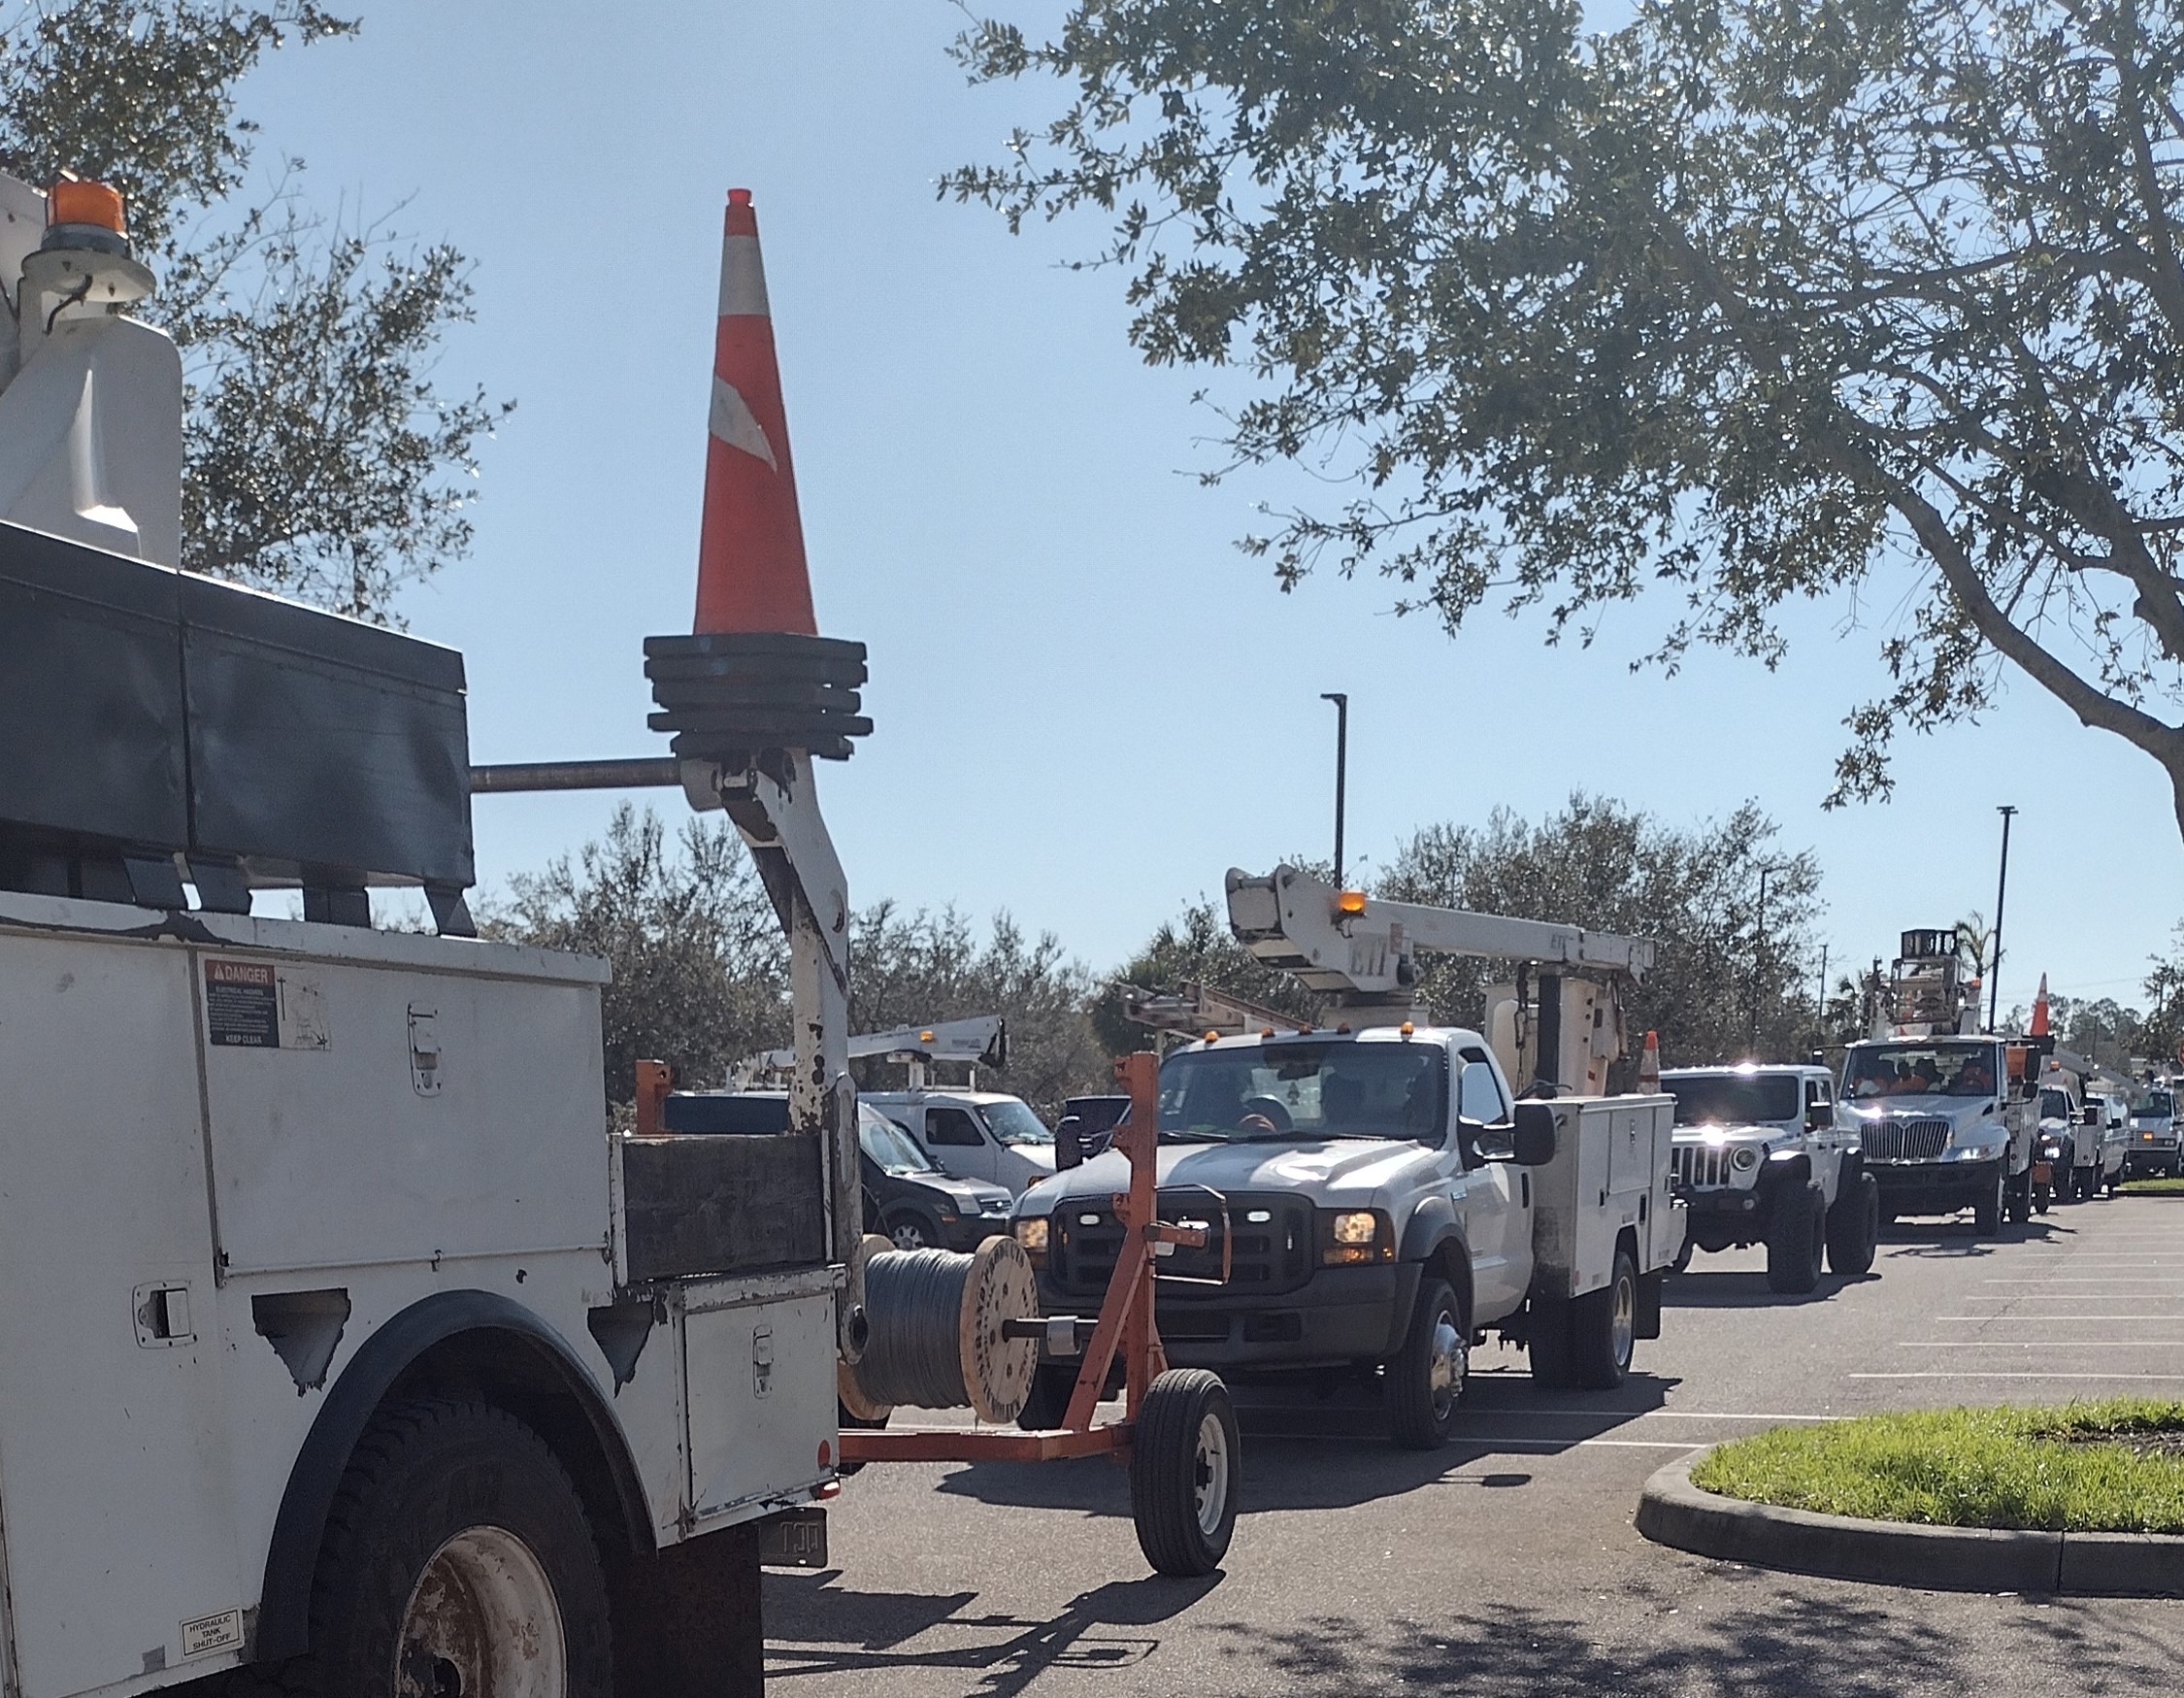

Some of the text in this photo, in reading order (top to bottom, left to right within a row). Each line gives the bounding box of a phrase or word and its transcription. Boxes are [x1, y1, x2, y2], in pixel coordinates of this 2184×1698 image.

[225, 965, 268, 983] DANGER
[225, 1034, 263, 1045] KEEP CLEAR
[189, 1615, 231, 1632] HYDRAULIC
[201, 1626, 221, 1638] TANK
[192, 1632, 231, 1649] SHUT-OFF
